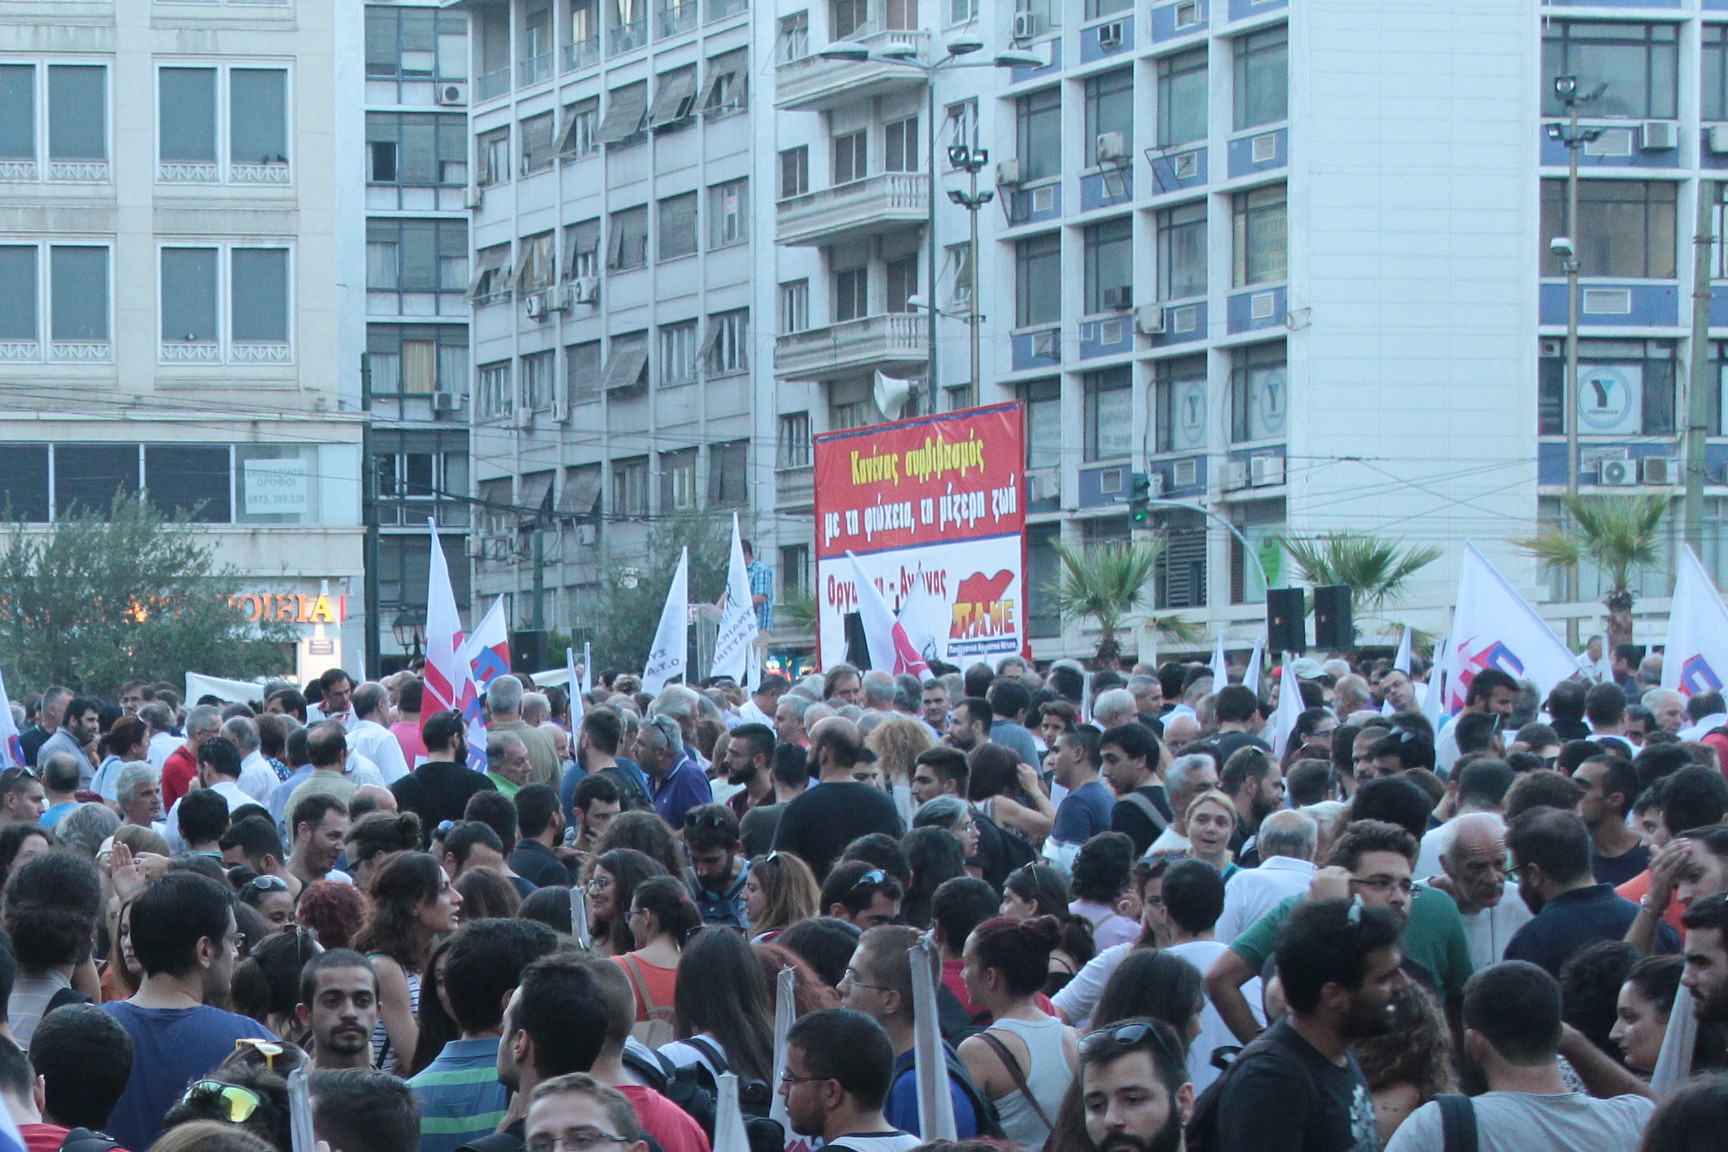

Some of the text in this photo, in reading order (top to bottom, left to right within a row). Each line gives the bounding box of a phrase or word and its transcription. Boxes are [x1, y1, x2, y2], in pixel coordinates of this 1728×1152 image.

[850, 428, 985, 486] Κανένας συμβιβασμός
[824, 511, 841, 548] με
[845, 509, 860, 536] τη
[920, 497, 934, 525] τη
[939, 481, 986, 533] μίζερη
[991, 472, 1017, 525] ζωή
[900, 559, 947, 603] Αγνας
